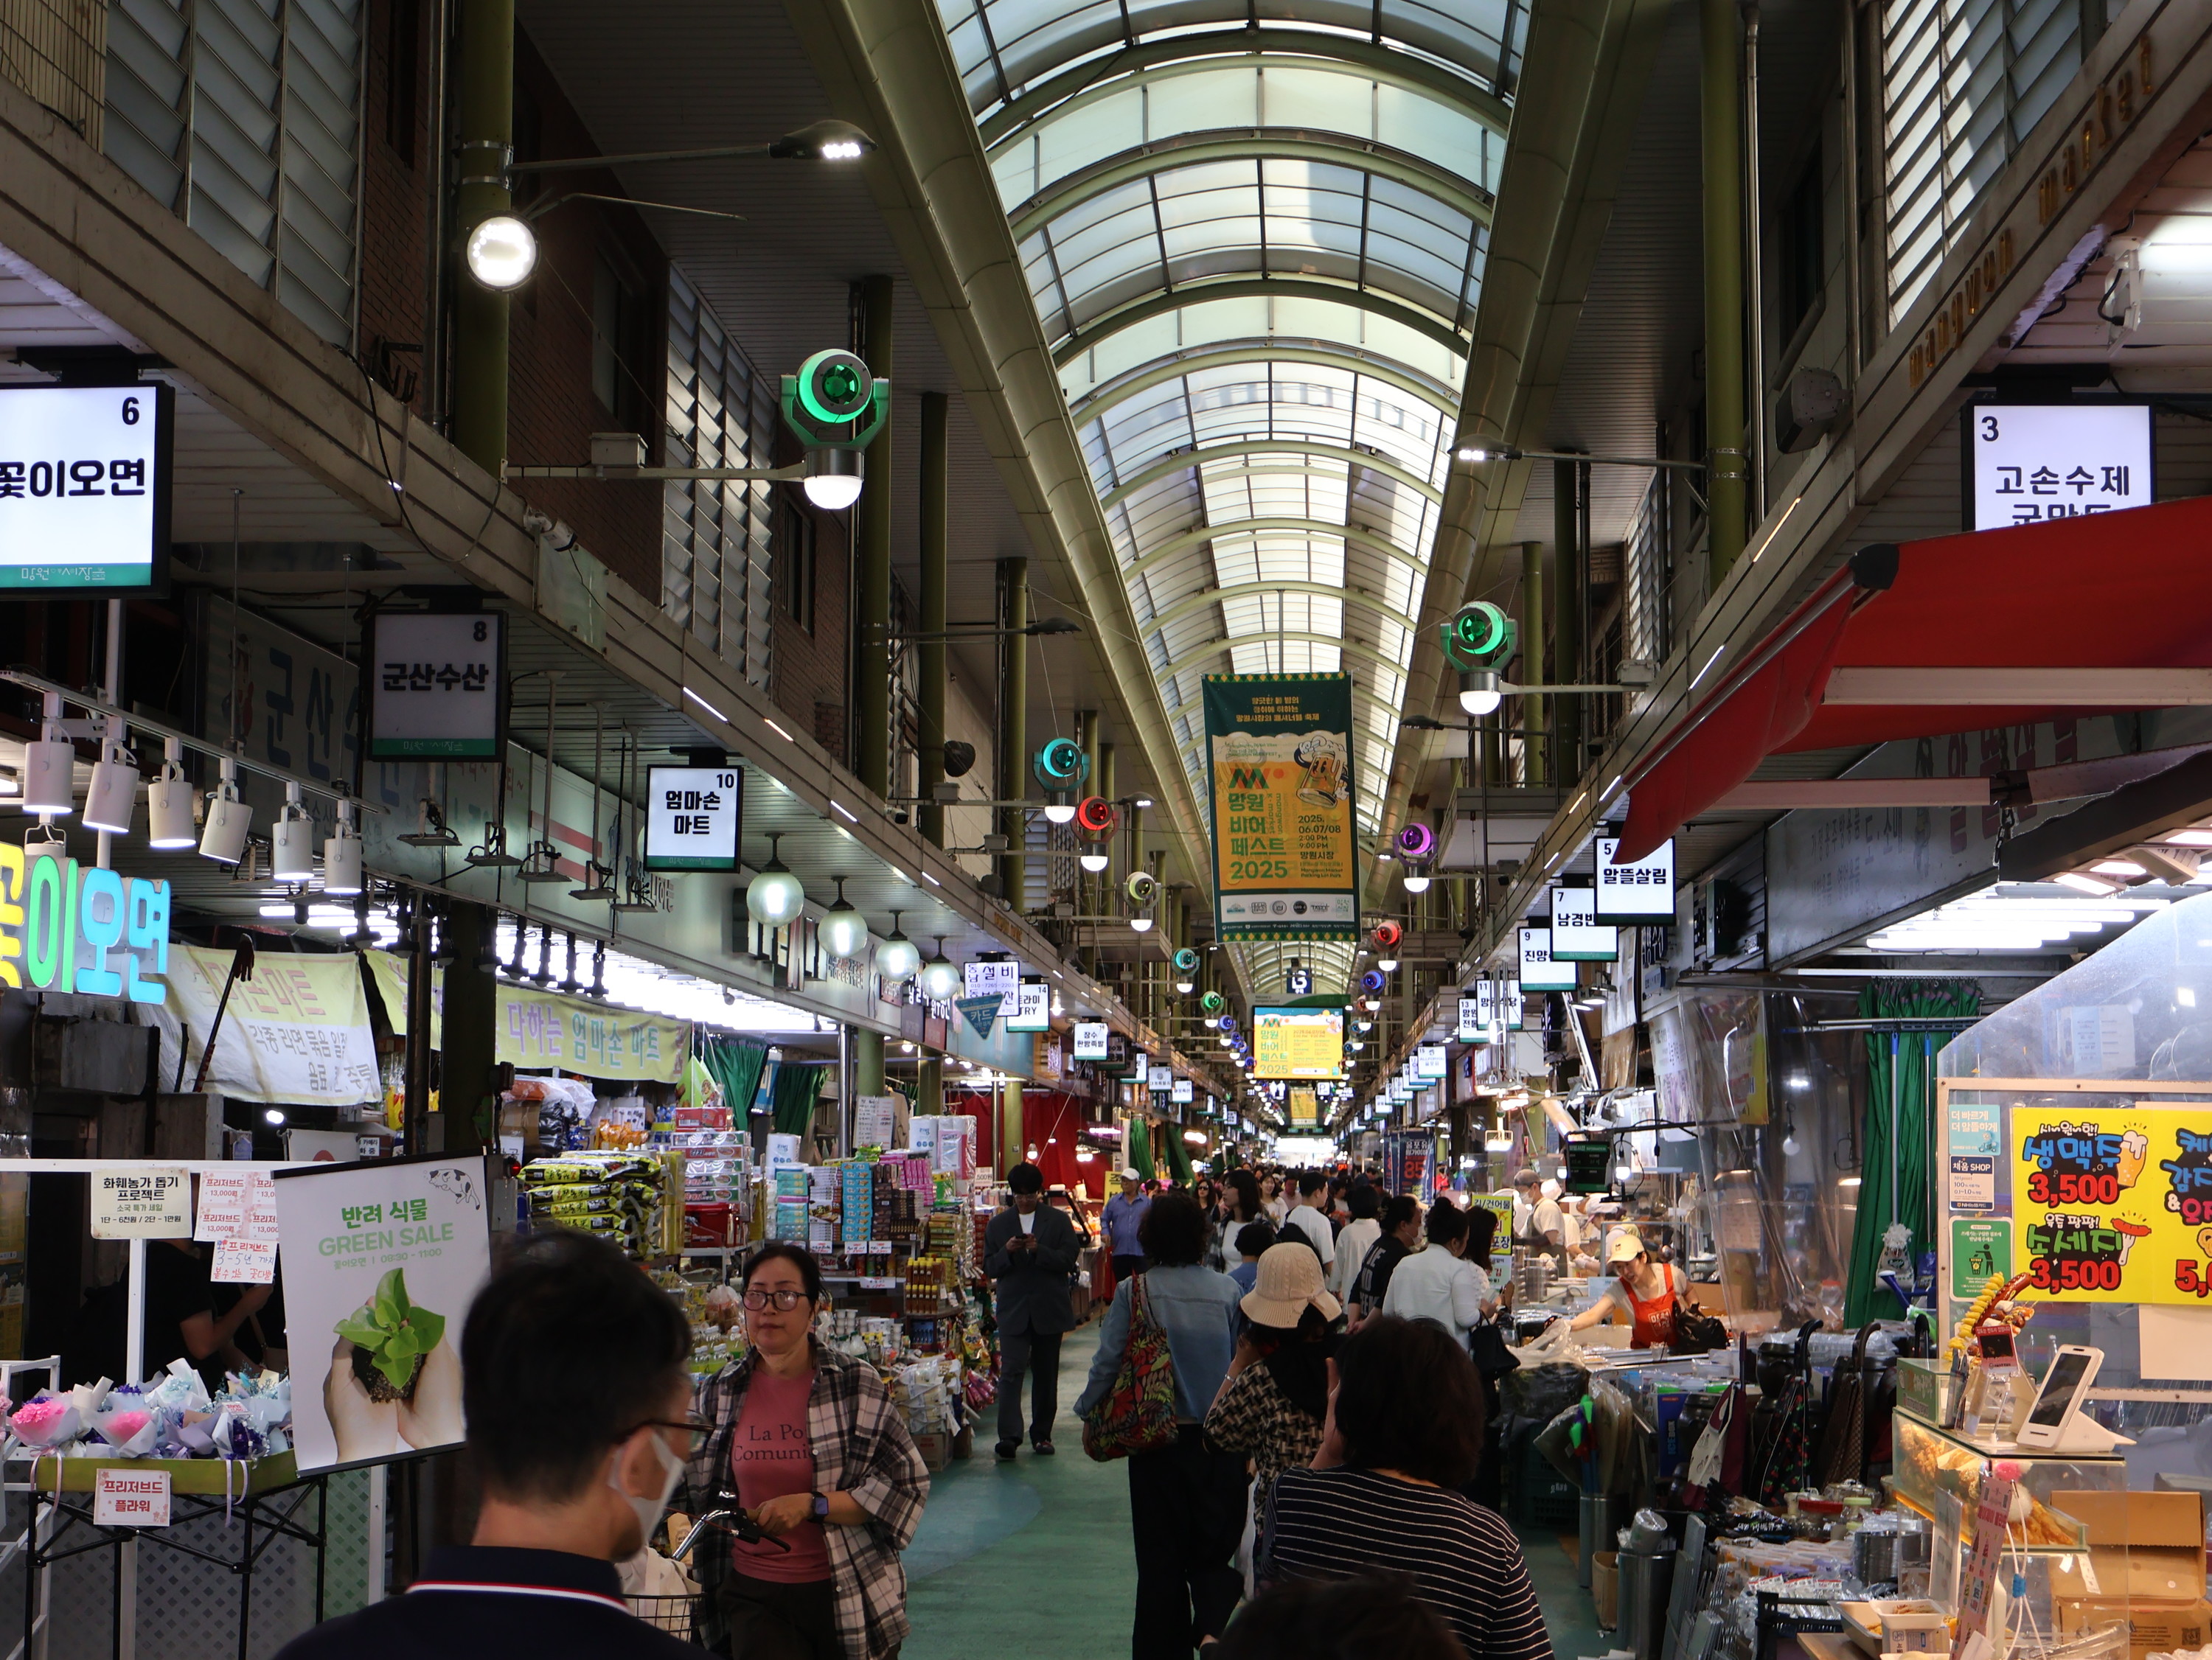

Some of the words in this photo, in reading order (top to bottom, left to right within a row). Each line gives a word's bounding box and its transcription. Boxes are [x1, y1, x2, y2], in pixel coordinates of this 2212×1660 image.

[122, 397, 140, 425] 6
[1981, 416, 2000, 442] 3
[1994, 465, 2130, 497] 고손수제
[473, 621, 487, 642] 8
[382, 663, 490, 691] 군산수산
[716, 773, 734, 789] 10
[665, 790, 721, 811] 엄마손
[1228, 792, 1265, 812] 망원
[673, 815, 710, 834] 마트
[1230, 815, 1266, 834] 비어
[1298, 815, 1325, 824] 2025.
[1298, 825, 1341, 834] 06.07/08
[1231, 837, 1287, 856] 페스트
[1603, 843, 1612, 855] 5
[1300, 851, 1335, 860] 망원시장
[1230, 860, 1288, 879] 2025
[1603, 868, 1667, 885] 알뜰살림
[1557, 891, 1565, 902] 7
[1524, 932, 1531, 941] 9
[1524, 949, 1551, 963] 진양
[983, 965, 1014, 981] 설비
[1478, 983, 1488, 991] 11
[970, 1010, 993, 1022] 카드
[248, 1025, 279, 1054] 각종
[277, 1028, 308, 1056] 라면
[571, 1011, 625, 1067] 엄마손
[630, 1024, 661, 1068] 마트
[1260, 1030, 1279, 1039] 망원
[1260, 1042, 1279, 1051] 비어
[1260, 1053, 1289, 1062] 페스트
[1259, 1064, 1289, 1075] 2025
[1951, 1110, 1961, 1120] 더
[1961, 1110, 1989, 1120] 빠르게
[1951, 1122, 1961, 1132] 더
[1961, 1122, 1998, 1133] 알뜰하게
[2023, 1134, 2124, 1171] 생맥주
[1952, 1159, 1969, 1171] 채움
[1969, 1163, 1991, 1171] SHOP
[102, 1176, 152, 1189] 화훼농가
[155, 1176, 179, 1188] 돕기
[206, 1179, 244, 1188] 프리저브드
[2028, 1173, 2118, 1207] 3,500
[116, 1189, 165, 1202] 프로젝트
[116, 1204, 131, 1213] 소국
[133, 1204, 147, 1212] 특가
[148, 1203, 164, 1212] 세일
[341, 1204, 383, 1230] 반려
[389, 1198, 428, 1224] 식물
[164, 1215, 181, 1223] 1만원
[203, 1214, 241, 1223] 프리저브드
[253, 1215, 278, 1223] 프리저
[2045, 1213, 2065, 1229] 육즙
[2067, 1215, 2100, 1230] 팡팡!
[318, 1230, 394, 1257] GREEN
[399, 1222, 454, 1247] SALE
[2028, 1224, 2123, 1255] 소세지
[258, 1256, 274, 1266] 까지
[380, 1252, 408, 1264] 08:30
[249, 1268, 272, 1281] 꽃다발
[2031, 1258, 2121, 1293] 3,500
[749, 1426, 773, 1441] La
[779, 1424, 804, 1440] Po
[734, 1444, 811, 1462] Comuni
[103, 1479, 163, 1495] 프리저브드
[114, 1498, 151, 1514] 플라워
